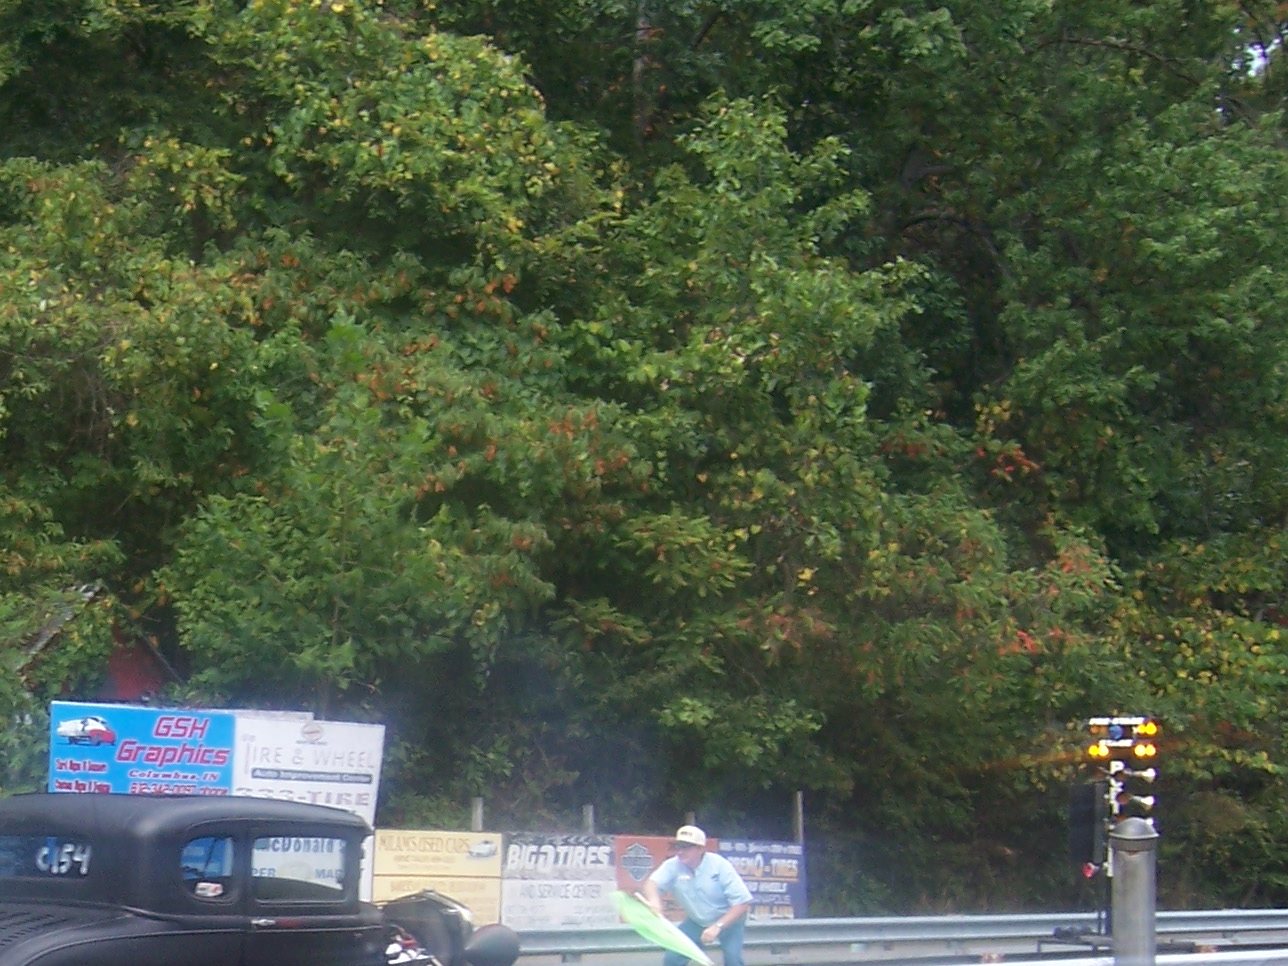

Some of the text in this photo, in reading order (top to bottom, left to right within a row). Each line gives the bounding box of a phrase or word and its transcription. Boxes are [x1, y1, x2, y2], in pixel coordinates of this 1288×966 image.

[153, 715, 210, 739] GSH
[116, 740, 231, 767] Graphics
[292, 747, 305, 765] &
[313, 748, 375, 769] WHEEL
[202, 771, 220, 781] IN
[506, 843, 537, 871] BIG
[556, 845, 611, 869] TIRES
